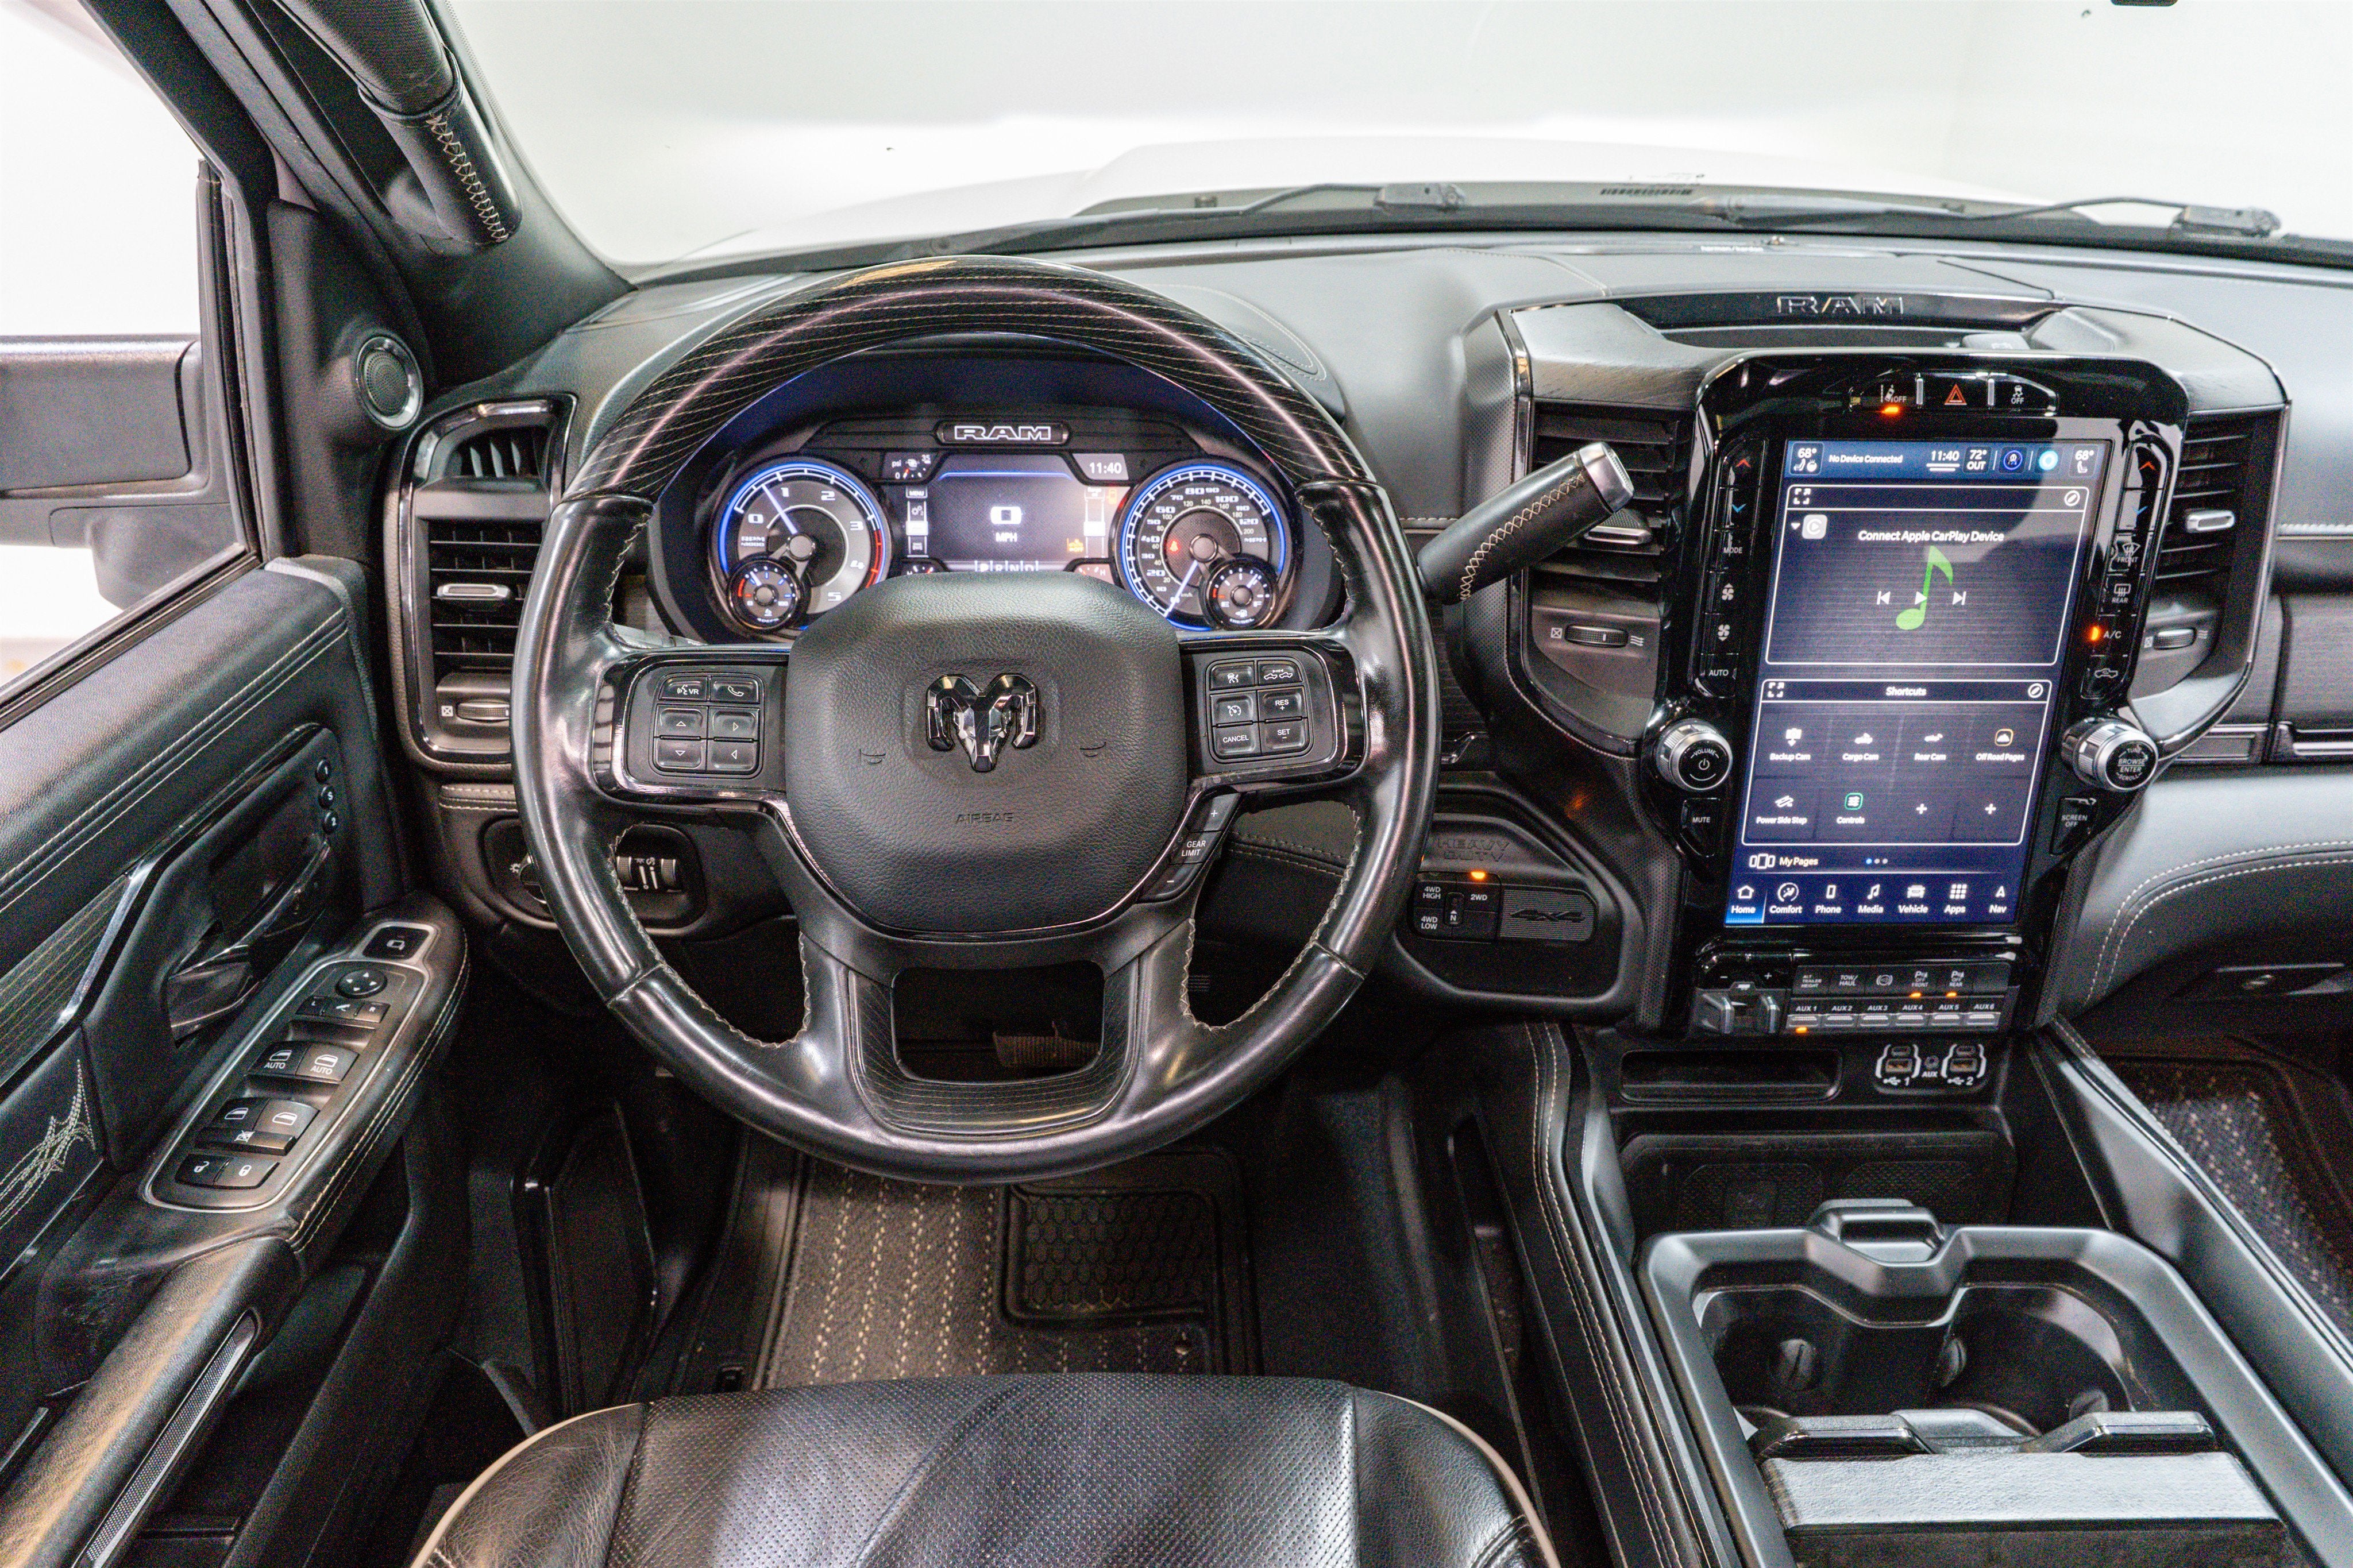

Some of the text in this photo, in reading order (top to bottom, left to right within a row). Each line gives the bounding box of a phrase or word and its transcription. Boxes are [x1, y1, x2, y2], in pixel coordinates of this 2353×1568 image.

[1777, 296, 1904, 314] RAM
[954, 426, 1051, 440] RAM
[1840, 455, 1864, 463] Device
[1865, 455, 1903, 463] Connected
[1931, 450, 1959, 461] 11:40
[1089, 462, 1122, 474] 11:40
[1966, 461, 1986, 470] OUT
[781, 488, 789, 497] 1
[821, 491, 835, 500] 2
[748, 513, 763, 524] 0
[990, 506, 1022, 524] 0
[850, 521, 863, 530] 3
[996, 532, 1017, 542] MPH
[1858, 530, 2004, 543] Connect Apple CarPlay Device
[850, 560, 865, 569] 4
[828, 592, 842, 601] 5
[2103, 630, 2122, 639] A/C
[1886, 686, 1926, 696] Shortcuts
[1222, 735, 1249, 743] CANCEL
[1694, 748, 1716, 756] VOLUME
[1770, 753, 1795, 762] Backup
[1842, 753, 1863, 762] Cargo
[2005, 754, 2025, 762] Pages
[331, 817, 337, 826] 2
[956, 812, 1014, 824] AIRBAG
[1791, 817, 1807, 825] Step
[1837, 816, 1865, 824] Controls
[1187, 840, 1206, 848] GEAR
[1438, 838, 1509, 850] HEAVY
[1779, 857, 1819, 867] My Pages
[1731, 905, 1756, 913] Home
[1769, 905, 1803, 914] Comfort
[1815, 905, 1842, 913] Phone
[1858, 905, 1884, 913] Media
[1898, 905, 1928, 913] Vehicle
[1944, 905, 1966, 914] Apps
[1989, 905, 2007, 913] Nav
[310, 1065, 333, 1075] AUTO
[1904, 1076, 1910, 1086] 1
[1966, 1076, 1974, 1086] 2
